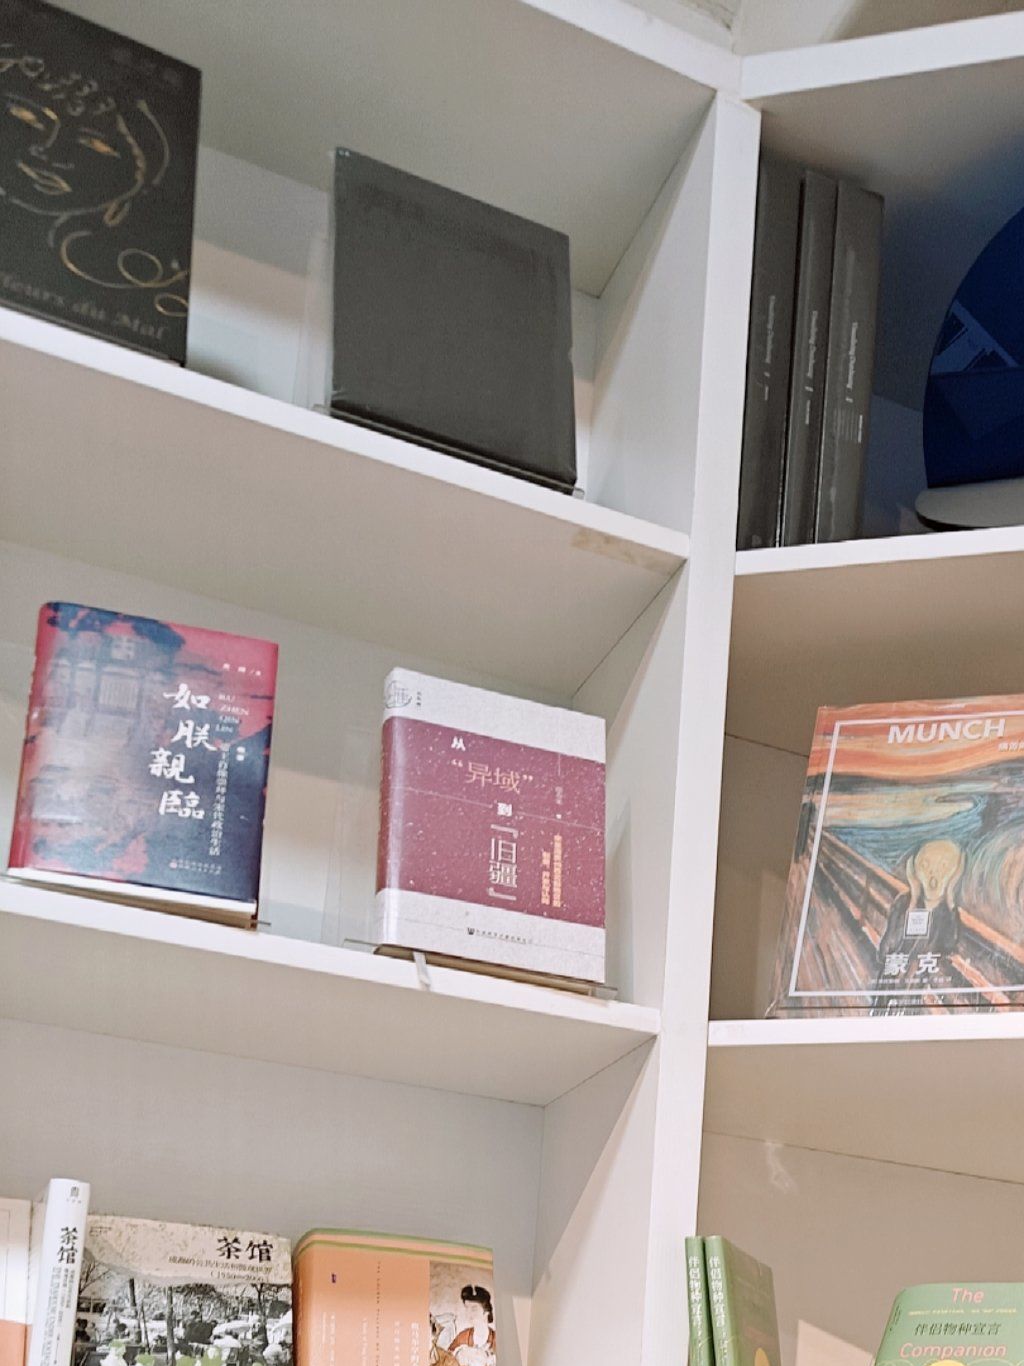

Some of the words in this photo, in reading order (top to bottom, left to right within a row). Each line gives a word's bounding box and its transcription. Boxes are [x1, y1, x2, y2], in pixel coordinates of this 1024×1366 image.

[887, 718, 1006, 744] MUNCH
[451, 737, 466, 751] 从
[884, 952, 942, 975] 蒙克
[57, 1227, 79, 1264] 茶馆
[215, 1236, 274, 1263] 茶馆
[951, 1287, 984, 1304] The
[914, 1321, 1001, 1337] 伴侣物种宣言
[900, 1342, 1007, 1360] Companion
